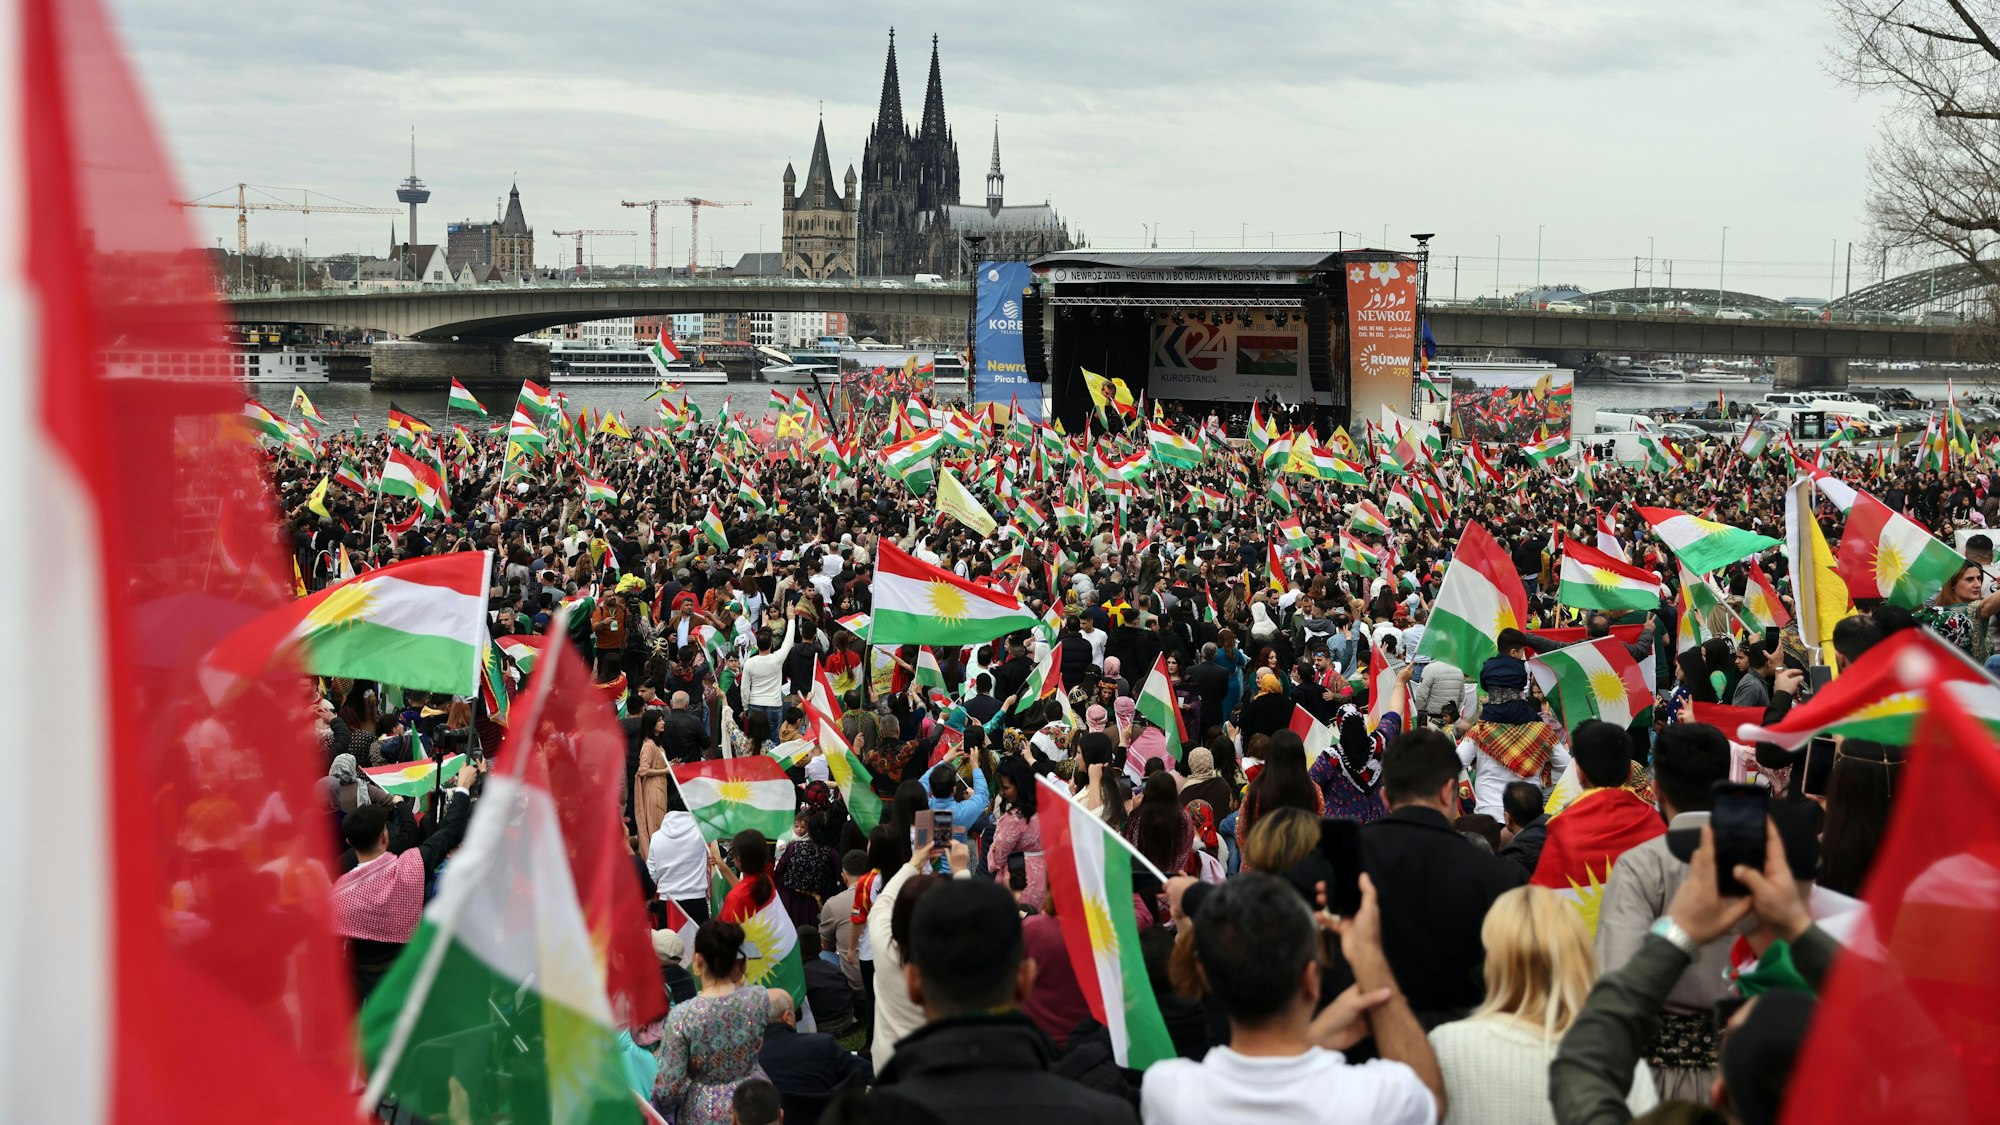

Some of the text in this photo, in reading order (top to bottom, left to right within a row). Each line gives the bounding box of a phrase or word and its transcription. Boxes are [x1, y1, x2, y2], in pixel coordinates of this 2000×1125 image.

[1071, 271, 1102, 280] NEWROZ
[1104, 271, 1121, 280] 2025
[1126, 271, 1164, 280] HEVGIRTIN
[1166, 271, 1172, 280] JI
[1174, 271, 1183, 280] BO
[1357, 310, 1411, 322] NEWROZ
[989, 319, 1023, 330] KORE
[1370, 353, 1410, 365] RÛDAW
[988, 360, 1026, 372] Newro
[994, 375, 1015, 383] Piroz
[1160, 374, 1217, 383] KURDISTAN24
